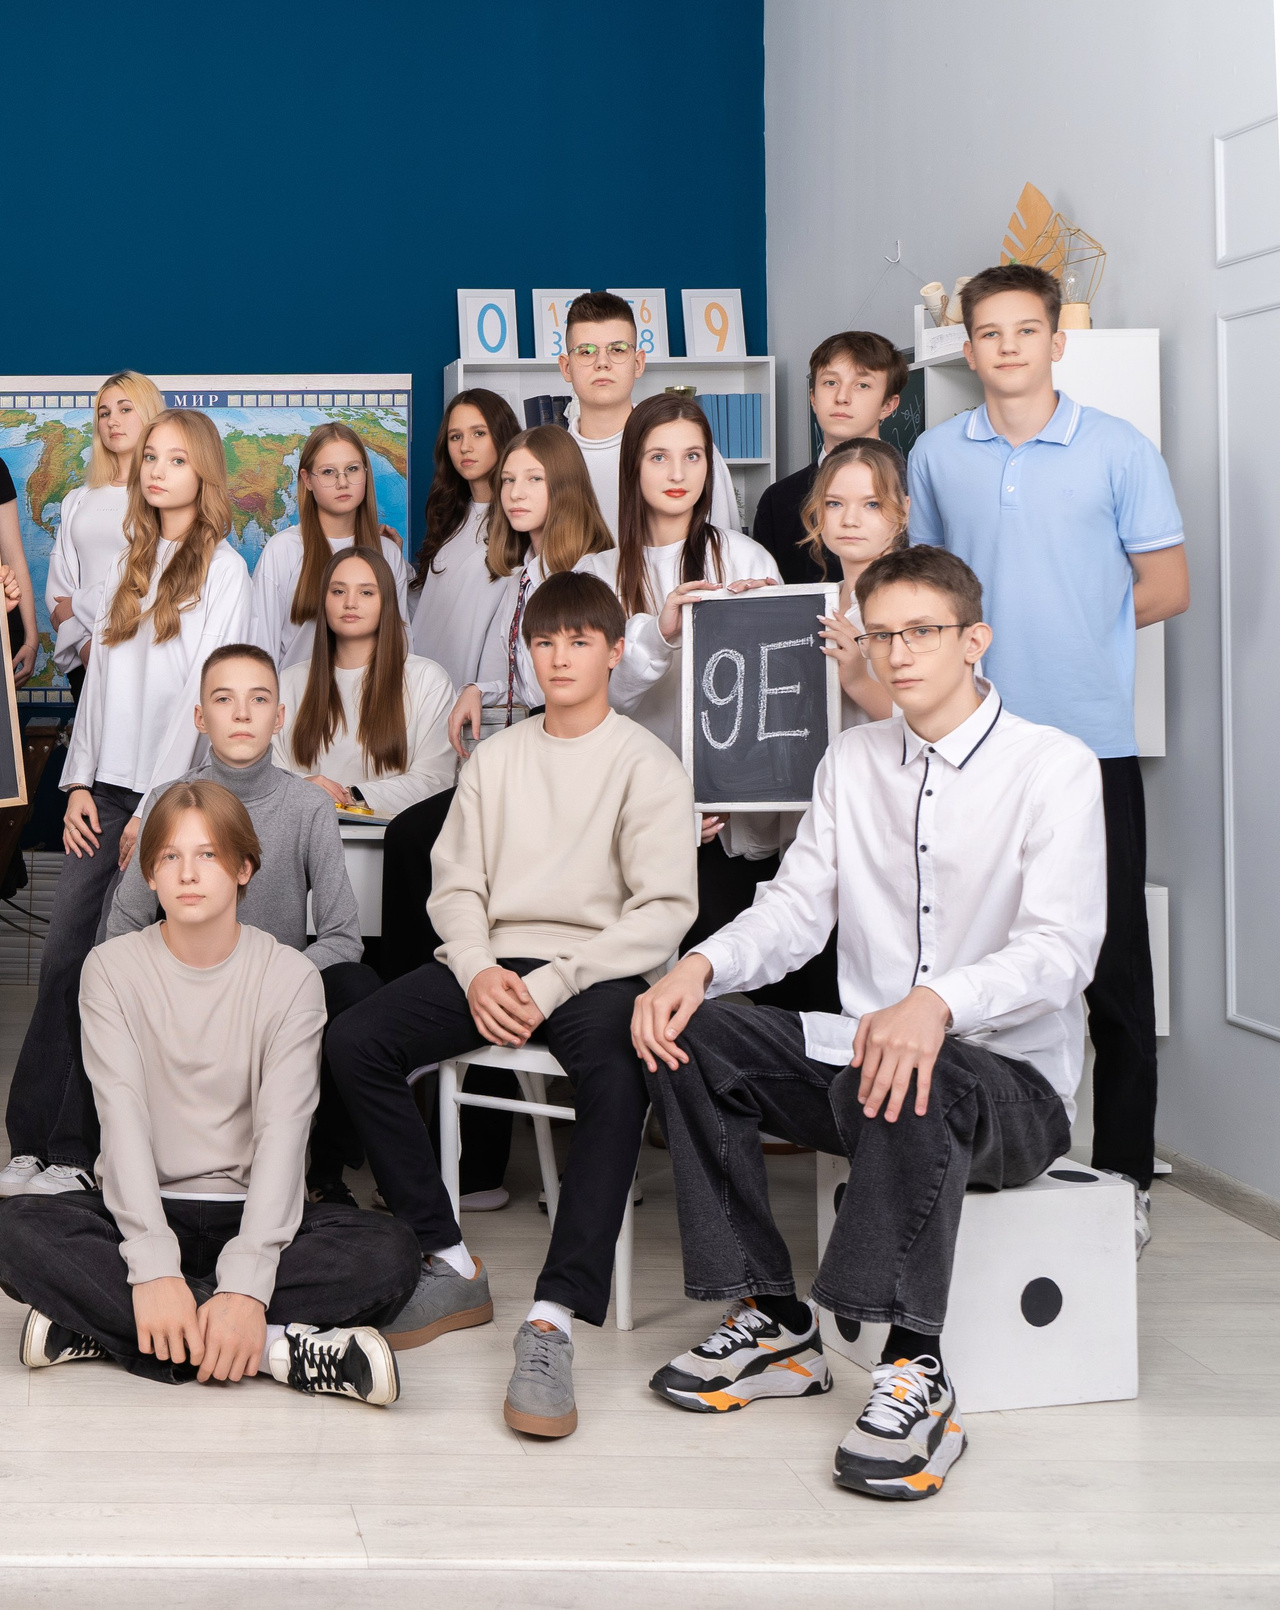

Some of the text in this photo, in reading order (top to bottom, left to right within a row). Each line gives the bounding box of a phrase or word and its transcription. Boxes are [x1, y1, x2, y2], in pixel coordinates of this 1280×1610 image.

[547, 302, 559, 328] 1
[640, 299, 652, 324] 6
[477, 303, 507, 354] 0
[704, 302, 729, 352] 9
[551, 331, 563, 356] 3
[639, 328, 655, 354] 8
[174, 394, 219, 407] МИР
[701, 634, 816, 750] 9Е
